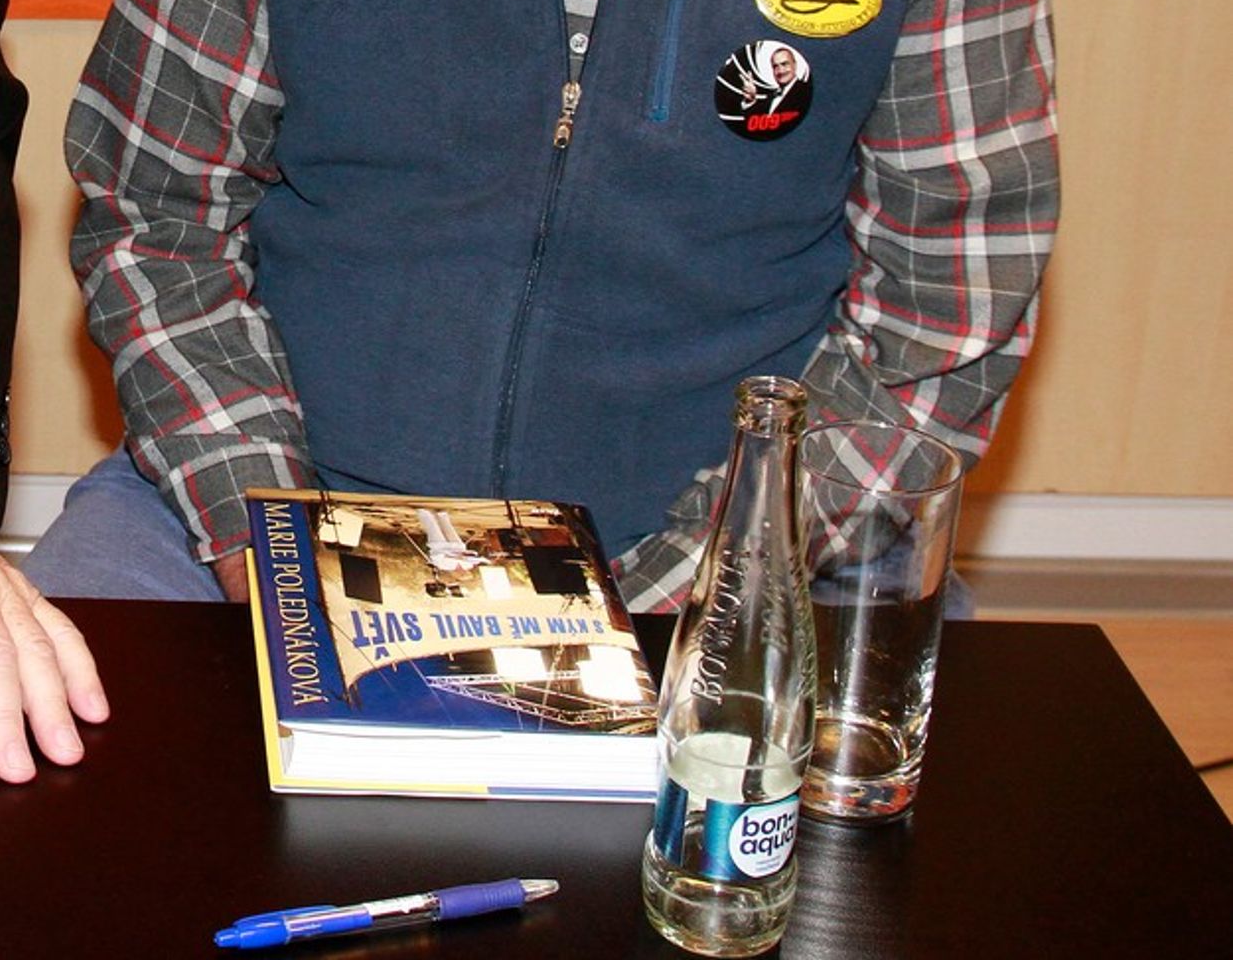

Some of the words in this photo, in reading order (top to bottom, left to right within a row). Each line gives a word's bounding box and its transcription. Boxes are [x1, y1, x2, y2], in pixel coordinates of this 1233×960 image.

[747, 114, 780, 131] 009
[263, 501, 298, 564] MARIE
[274, 564, 329, 706] POLEDŇÁKOVÁ
[350, 609, 423, 661] SVĚT
[430, 613, 502, 639] BAVIL
[508, 616, 541, 640] MĚ
[547, 617, 588, 635] KÝM
[593, 620, 604, 634] S
[740, 825, 794, 856] aqua
